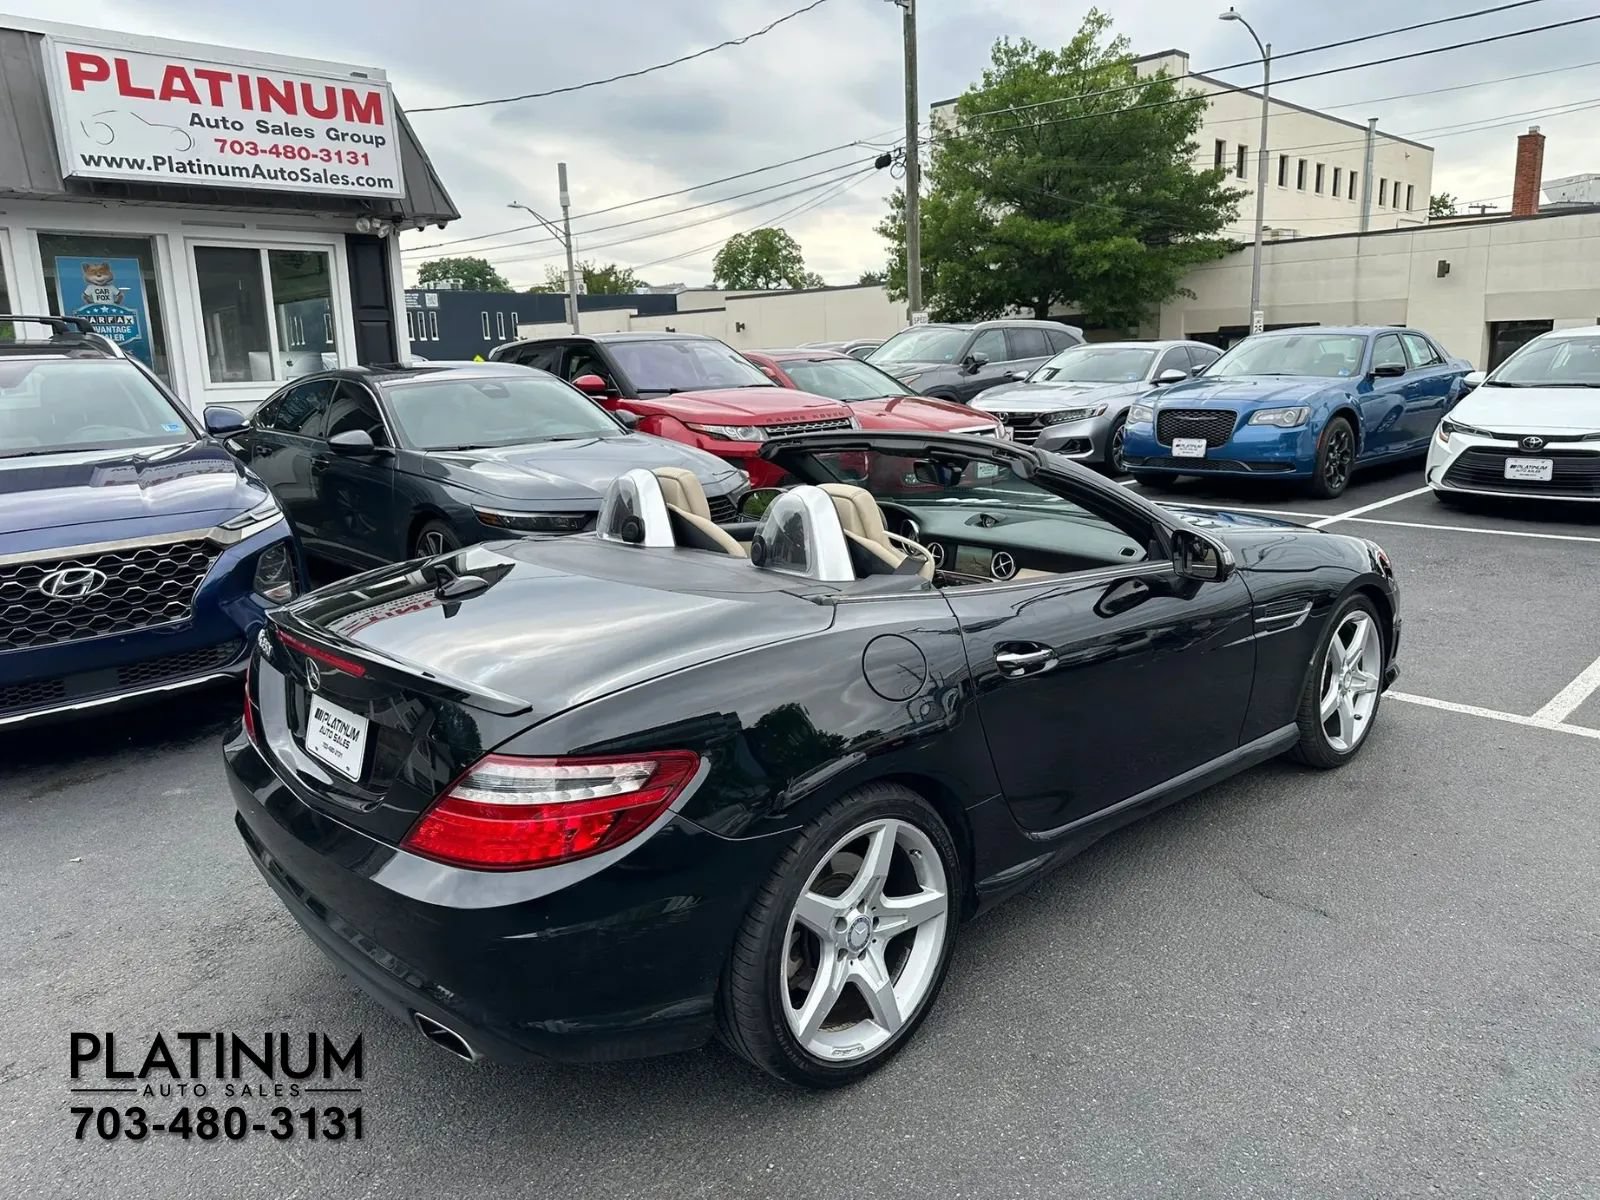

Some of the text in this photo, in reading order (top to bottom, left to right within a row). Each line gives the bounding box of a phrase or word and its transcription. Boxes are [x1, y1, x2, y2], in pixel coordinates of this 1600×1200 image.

[65, 51, 384, 126] PLATINUM
[189, 112, 386, 148] Auto Sales Group
[214, 138, 370, 167] 703-480-3131
[80, 153, 394, 189] www.PlatinumAutoSales.com
[81, 316, 134, 325] ARFAX
[93, 326, 132, 334] VANTAGE
[319, 725, 351, 750] AUTO SALES
[322, 712, 361, 742] PLATINUM
